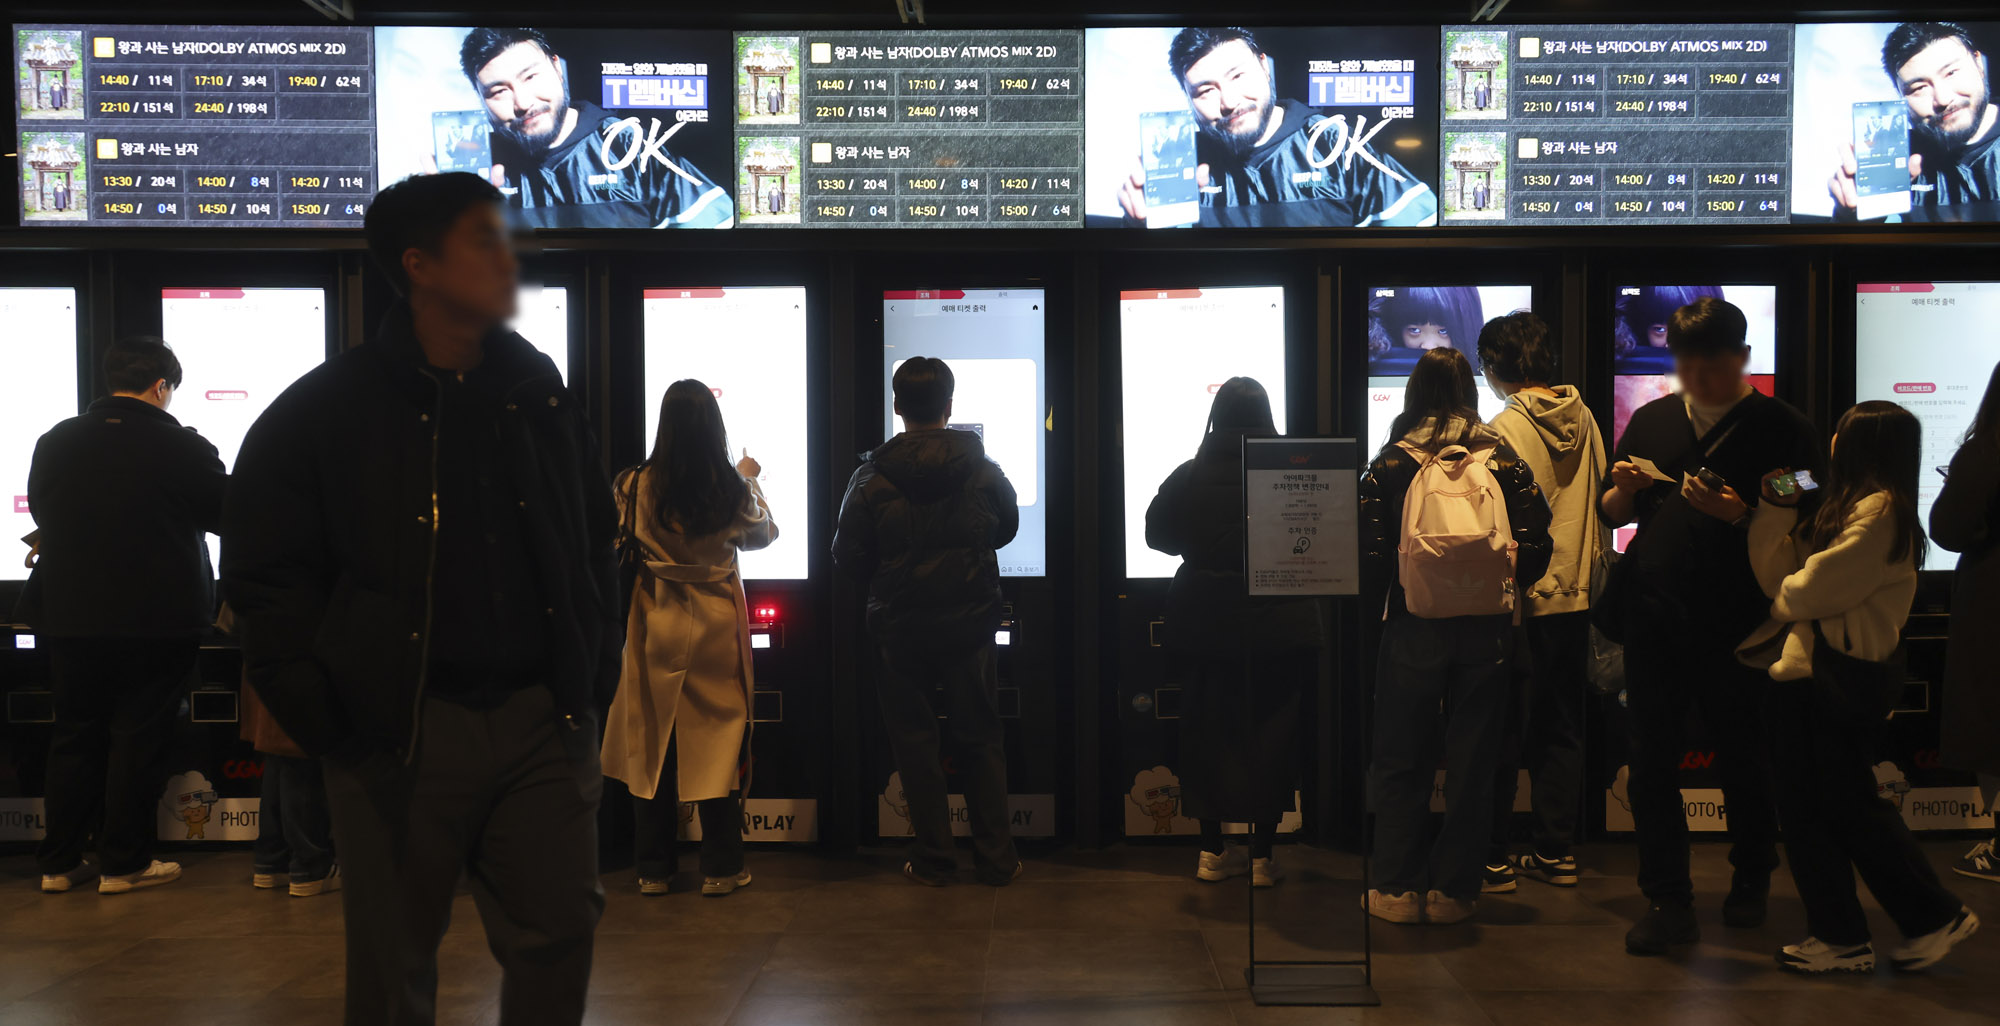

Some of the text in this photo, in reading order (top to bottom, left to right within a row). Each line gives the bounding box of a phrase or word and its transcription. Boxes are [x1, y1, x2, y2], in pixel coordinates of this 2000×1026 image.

[117, 40, 347, 56] 왕과 사는 남자(DOLBY ATMOS MIX 2D)
[834, 45, 1057, 61] 왕과 사는 남자(DOLBY ATMOS MIX 2D)
[1542, 40, 1769, 55] 왕과 사는 남자(DOLBY ATMOS MIX 2D)
[100, 74, 173, 87] 14:40 11석
[194, 75, 267, 87] 17:10 34석
[288, 76, 361, 88] 19:40 62석
[816, 79, 845, 91] 14:40
[863, 79, 887, 91] 11석
[908, 79, 937, 90] 17:10
[954, 78, 979, 91] 34석
[1000, 79, 1028, 90] 19:40
[1046, 78, 1070, 90] 62석
[1524, 73, 1597, 86] 14:40 11석
[1616, 73, 1689, 85] 17:10 34석
[1709, 73, 1782, 85] 19:40 62석
[100, 102, 174, 114] 22:10 151석
[194, 102, 268, 114] 24:40 198석
[816, 106, 845, 117] 22:10
[857, 106, 887, 118] 151석
[907, 106, 937, 117] 24:40
[948, 105, 979, 118] 198석
[1381, 106, 1414, 119] 이라면
[1523, 100, 1596, 113] 22:10 151석
[1615, 100, 1689, 113] 24:40 198석
[120, 142, 200, 157] 왕과 사는 남자
[600, 116, 704, 187] OK
[834, 145, 911, 160] 왕과 사는 남자
[1305, 113, 1407, 183] OK
[1541, 141, 1619, 156] 왕과 사는 남자
[103, 176, 176, 188] 13:30 20석
[197, 176, 270, 188] 14:00 8석
[291, 177, 363, 189] 14:20 11석
[817, 179, 846, 190] 13:30
[863, 178, 888, 191] 20석
[908, 178, 937, 190] 14:00
[960, 178, 979, 191] 8석
[1000, 178, 1029, 189] 14:20
[1047, 178, 1070, 190] 11석
[1523, 174, 1595, 186] 13:30 20석
[1615, 173, 1687, 186] 14:00 8석
[1707, 173, 1779, 185] 14:20 11석
[104, 203, 177, 215] 14:50 0석
[198, 203, 271, 215] 14:50 10석
[291, 204, 364, 216] 15:00 6석
[817, 206, 846, 217] 14:50
[869, 205, 888, 217] 0석
[908, 205, 937, 217] 14:50
[955, 205, 979, 217] 10석
[1000, 205, 1029, 216] 15:00
[1052, 204, 1071, 217] 6석
[1522, 201, 1594, 213] 14:50 0석
[1614, 200, 1687, 213] 14:50 10석
[1706, 200, 1779, 212] 15:00 6석
[941, 304, 987, 313] 예매 티켓 출력
[1911, 298, 1956, 307] 예매 티켓 출력
[1372, 393, 1391, 402] CGV
[1287, 527, 1302, 535] 주차
